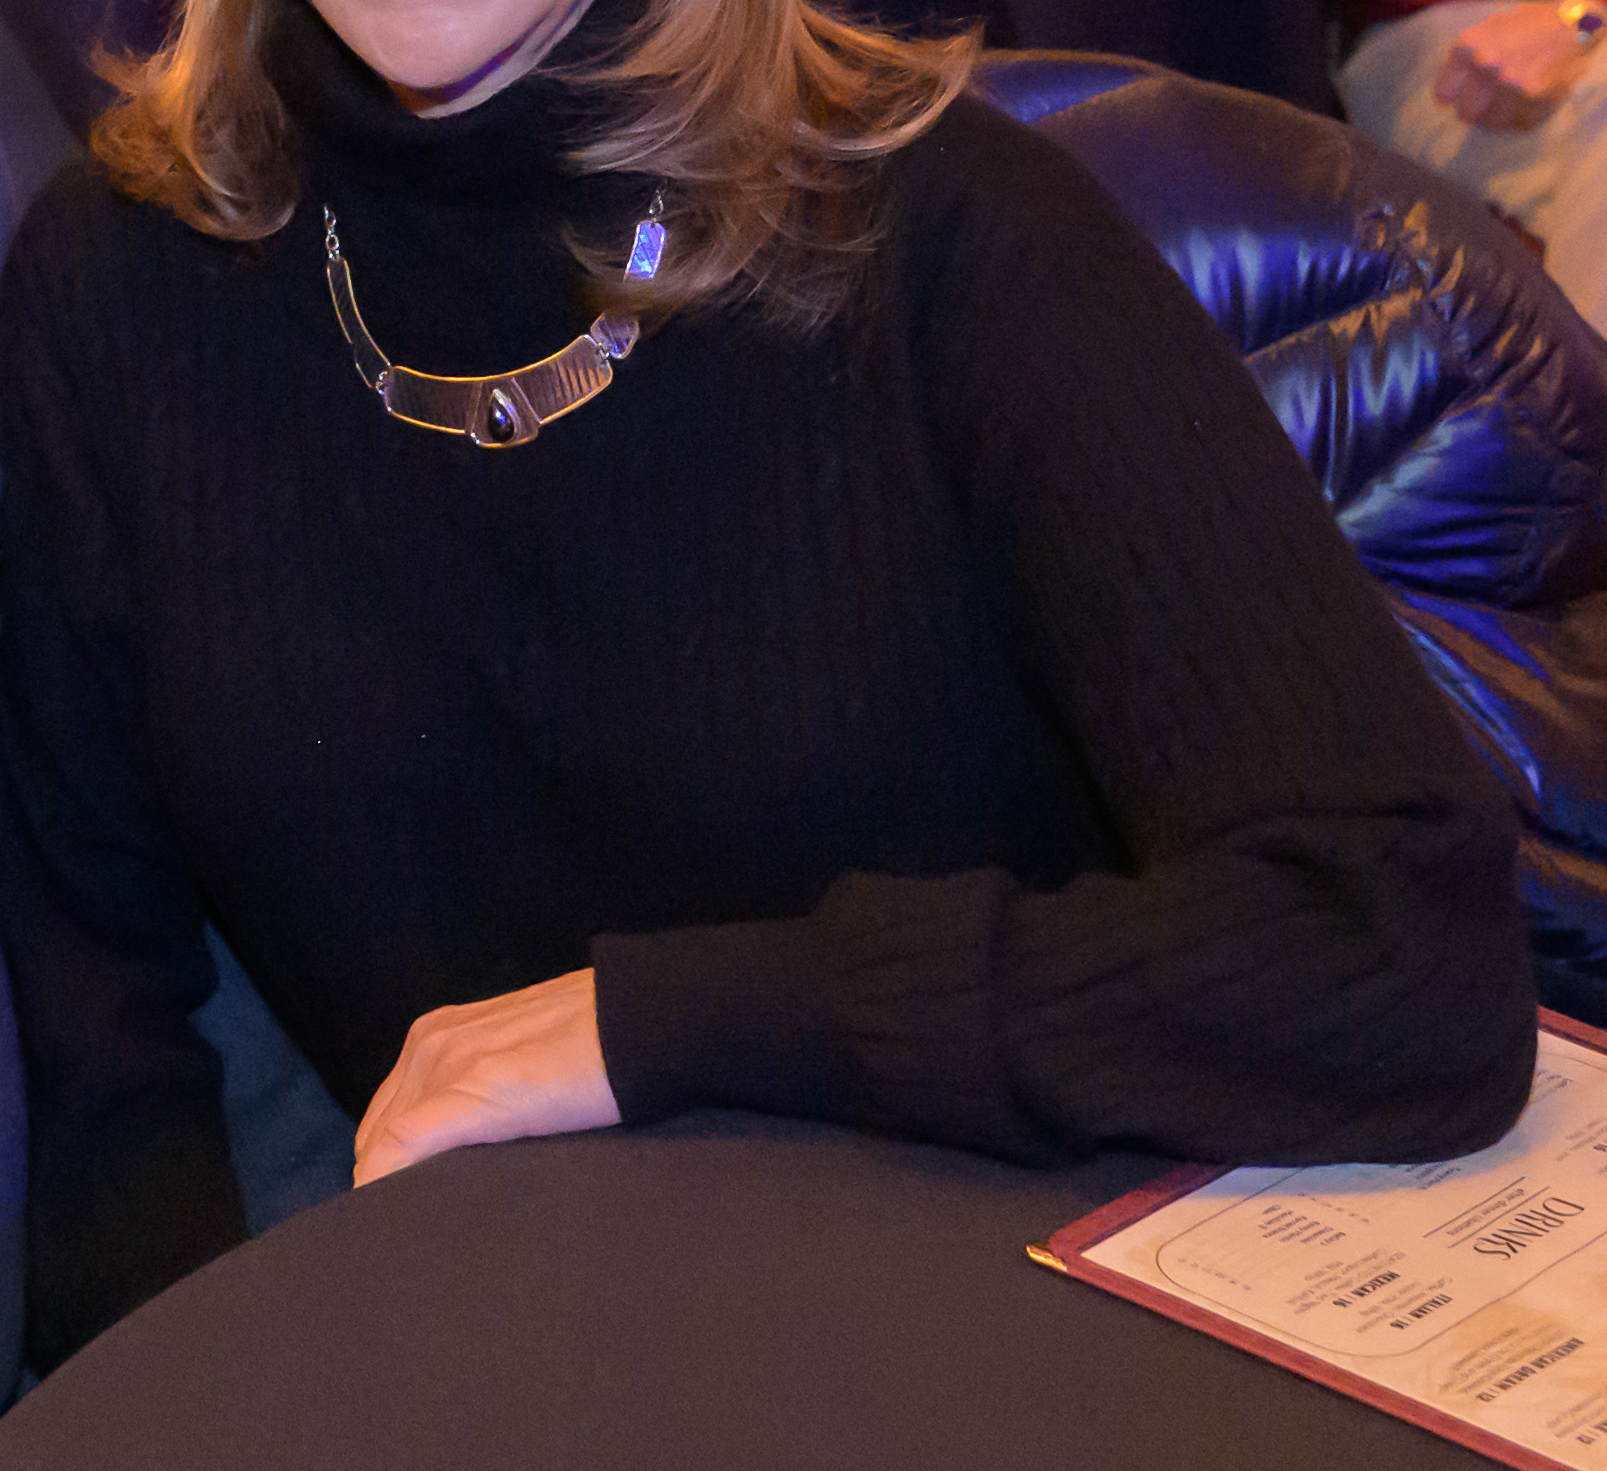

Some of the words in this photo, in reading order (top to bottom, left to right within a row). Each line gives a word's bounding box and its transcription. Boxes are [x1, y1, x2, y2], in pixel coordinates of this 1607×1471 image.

[1472, 1196, 1585, 1260] DRINKS
[1351, 1271, 1400, 1298] MEXICAN
[1332, 1297, 1353, 1309] 16
[1408, 1294, 1453, 1319] ITALIAN
[1389, 1319, 1409, 1330] 16
[1530, 1337, 1585, 1370] AMERICAN
[1494, 1365, 1537, 1391] DREAM
[1475, 1391, 1496, 1403] 12
